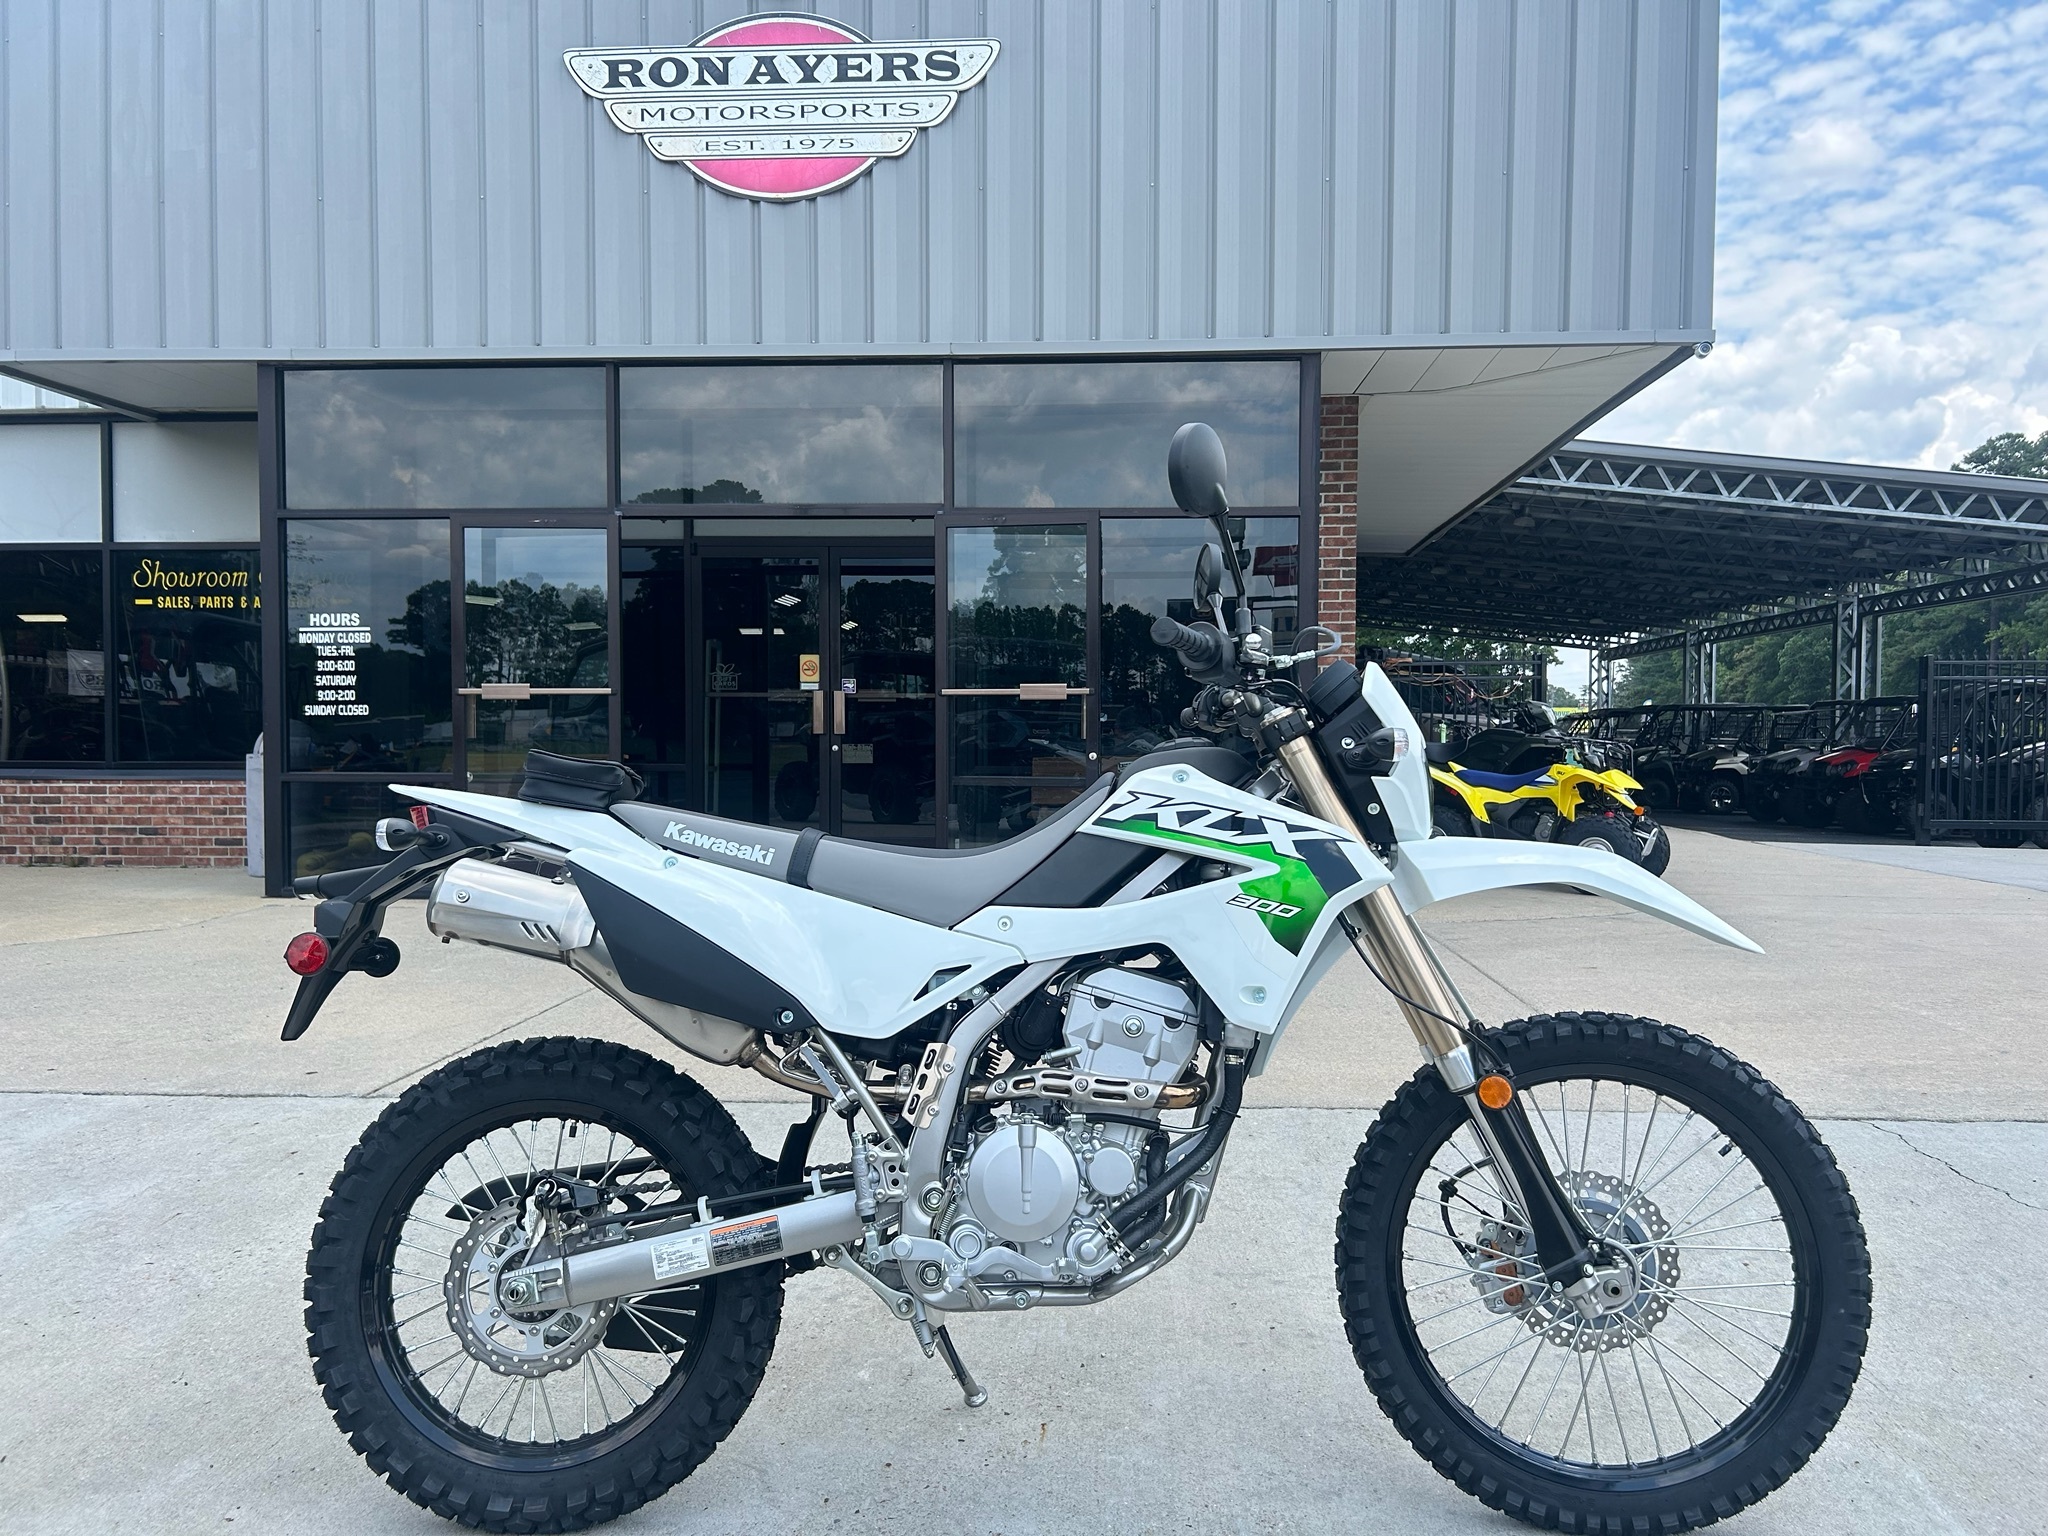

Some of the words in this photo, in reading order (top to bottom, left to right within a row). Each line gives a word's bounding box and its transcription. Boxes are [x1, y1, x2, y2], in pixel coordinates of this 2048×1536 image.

[601, 56, 734, 89] RON
[745, 50, 961, 85] AYERS
[640, 102, 920, 123] MOTORSPORTS
[704, 140, 765, 152] EST.
[782, 138, 855, 150] 1975
[133, 558, 248, 590] Showroom
[157, 596, 194, 610] SALES,
[200, 596, 234, 609] PARTS
[240, 596, 248, 609] &
[309, 613, 361, 627] HOURS
[298, 633, 335, 643] MONDAY
[337, 632, 371, 643] CLOSED
[317, 660, 355, 671] 9:00-6:00
[315, 675, 357, 686] SATURDAY
[317, 690, 356, 701] 9:00-2:00
[304, 705, 336, 715] SUNDAY
[338, 705, 369, 715] CLOSED
[1100, 791, 1356, 861] KLX
[663, 821, 775, 865] Kawasaki
[1226, 893, 1304, 919] 300
